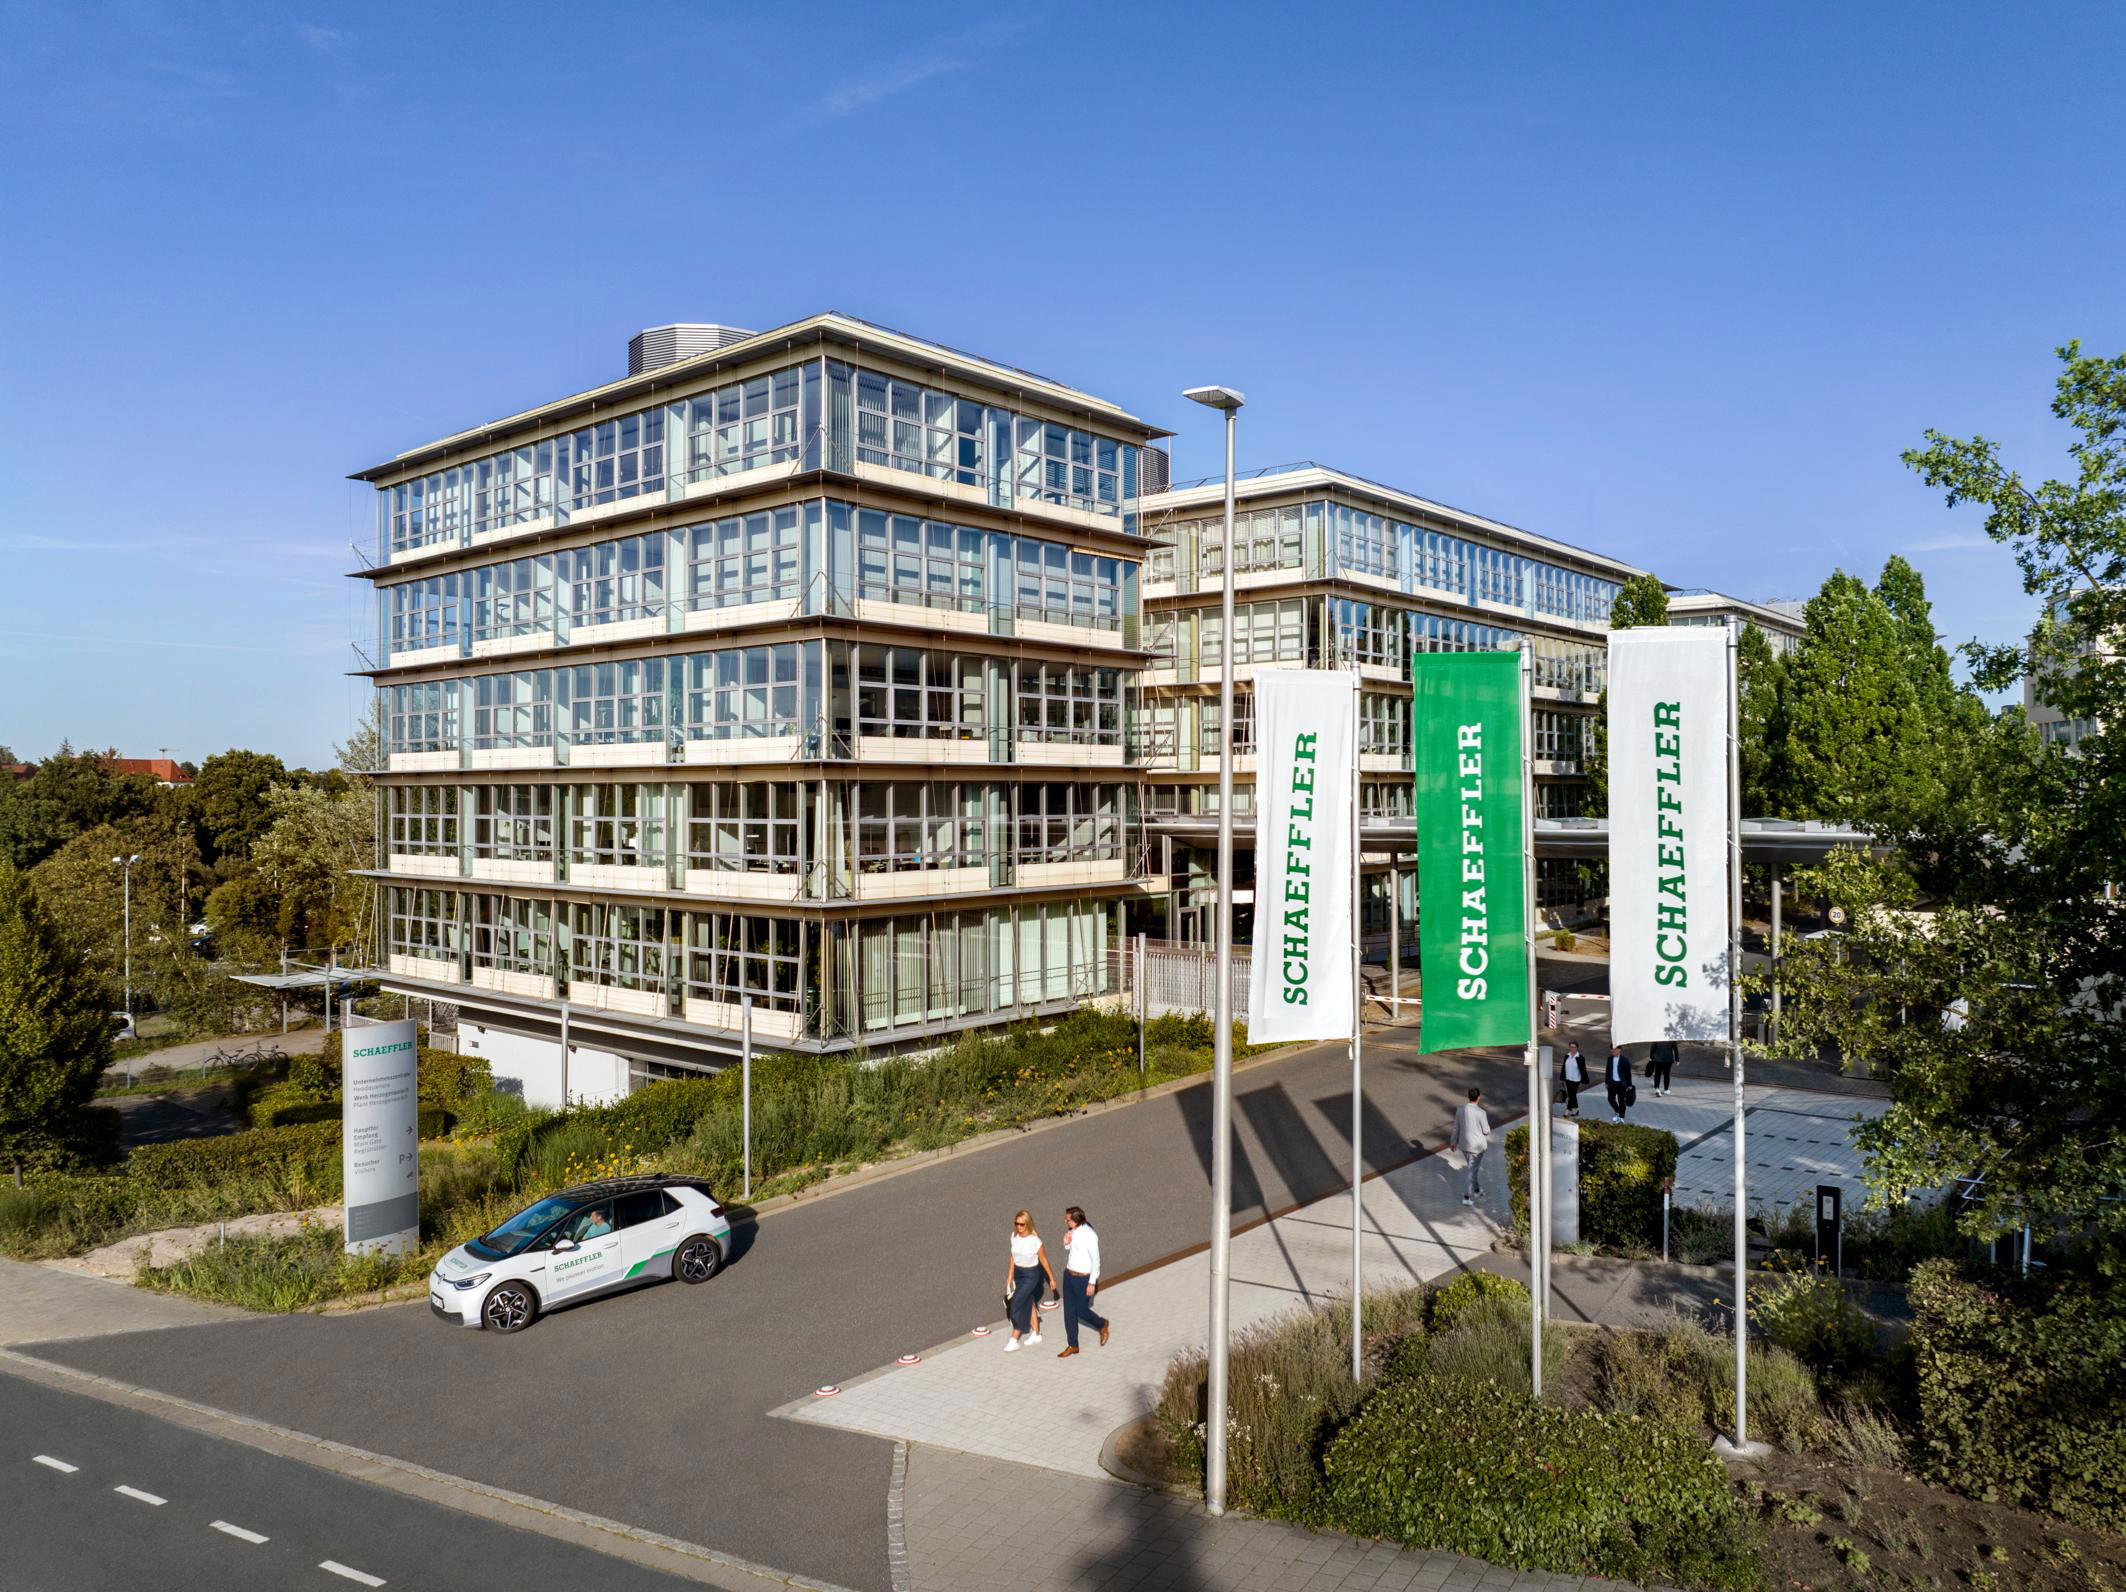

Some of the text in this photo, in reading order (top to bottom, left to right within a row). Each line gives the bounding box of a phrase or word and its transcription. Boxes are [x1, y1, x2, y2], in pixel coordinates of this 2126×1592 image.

[1282, 731, 1317, 1006] SCHAEFFLER
[1457, 722, 1489, 1001] SCHAEFFLER
[1653, 701, 1688, 989] SCHAEFFLER
[1832, 911, 1842, 919] 20
[353, 1041, 413, 1058] SCHAEFFLER
[554, 1251, 603, 1272] SCHAEFFLER
